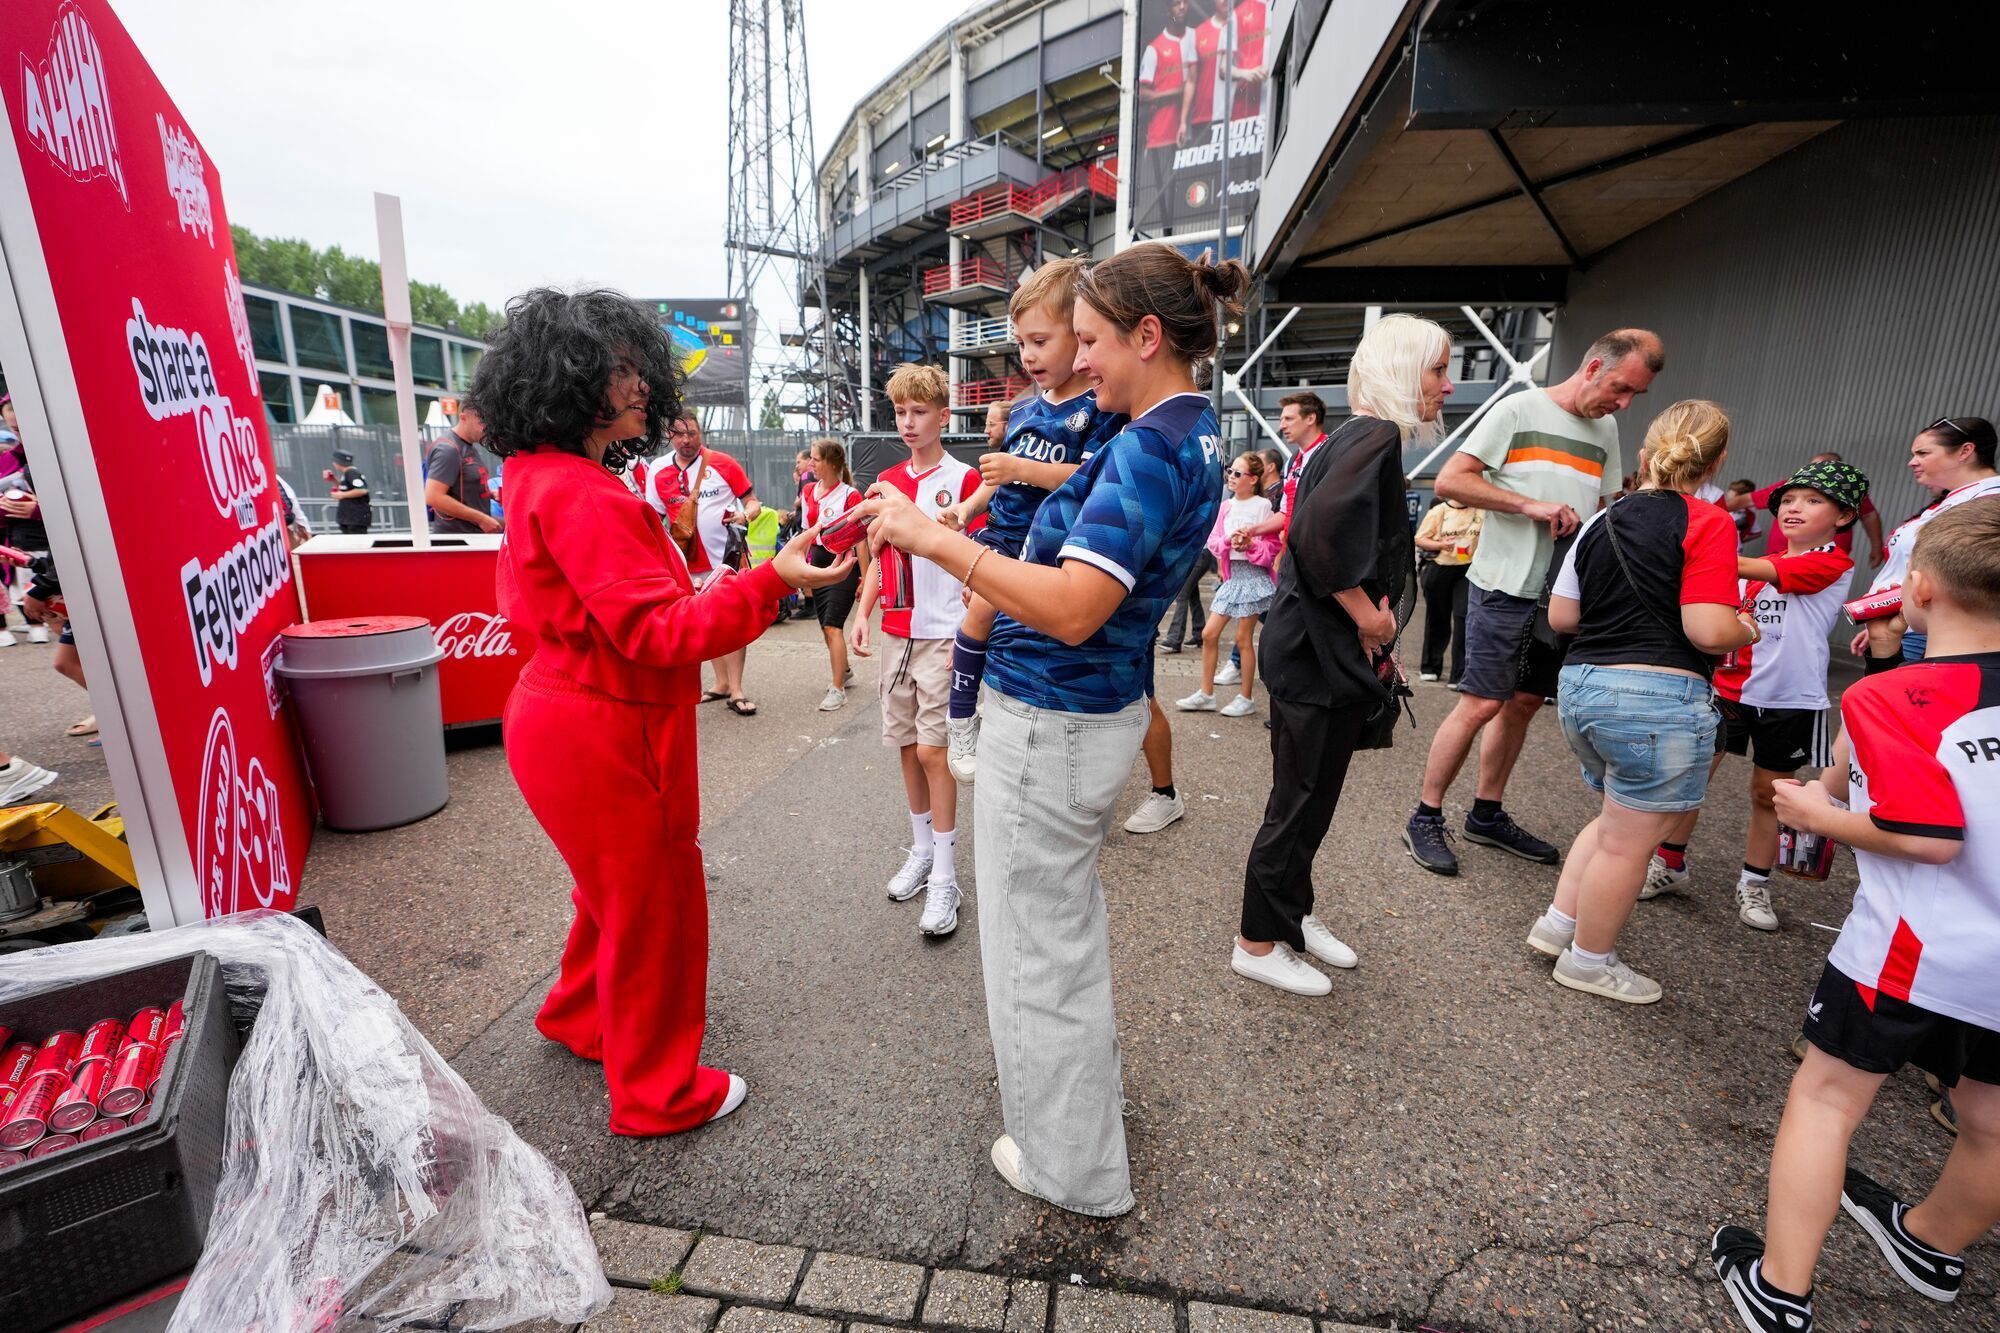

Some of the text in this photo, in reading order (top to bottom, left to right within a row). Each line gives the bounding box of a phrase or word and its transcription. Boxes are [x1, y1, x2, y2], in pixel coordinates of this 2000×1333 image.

[132, 314, 199, 405] share
[196, 344, 215, 396] a
[200, 404, 261, 508] Coke
[1010, 431, 1067, 464] Euro
[235, 497, 258, 527] with
[186, 512, 287, 671] Feyenoord
